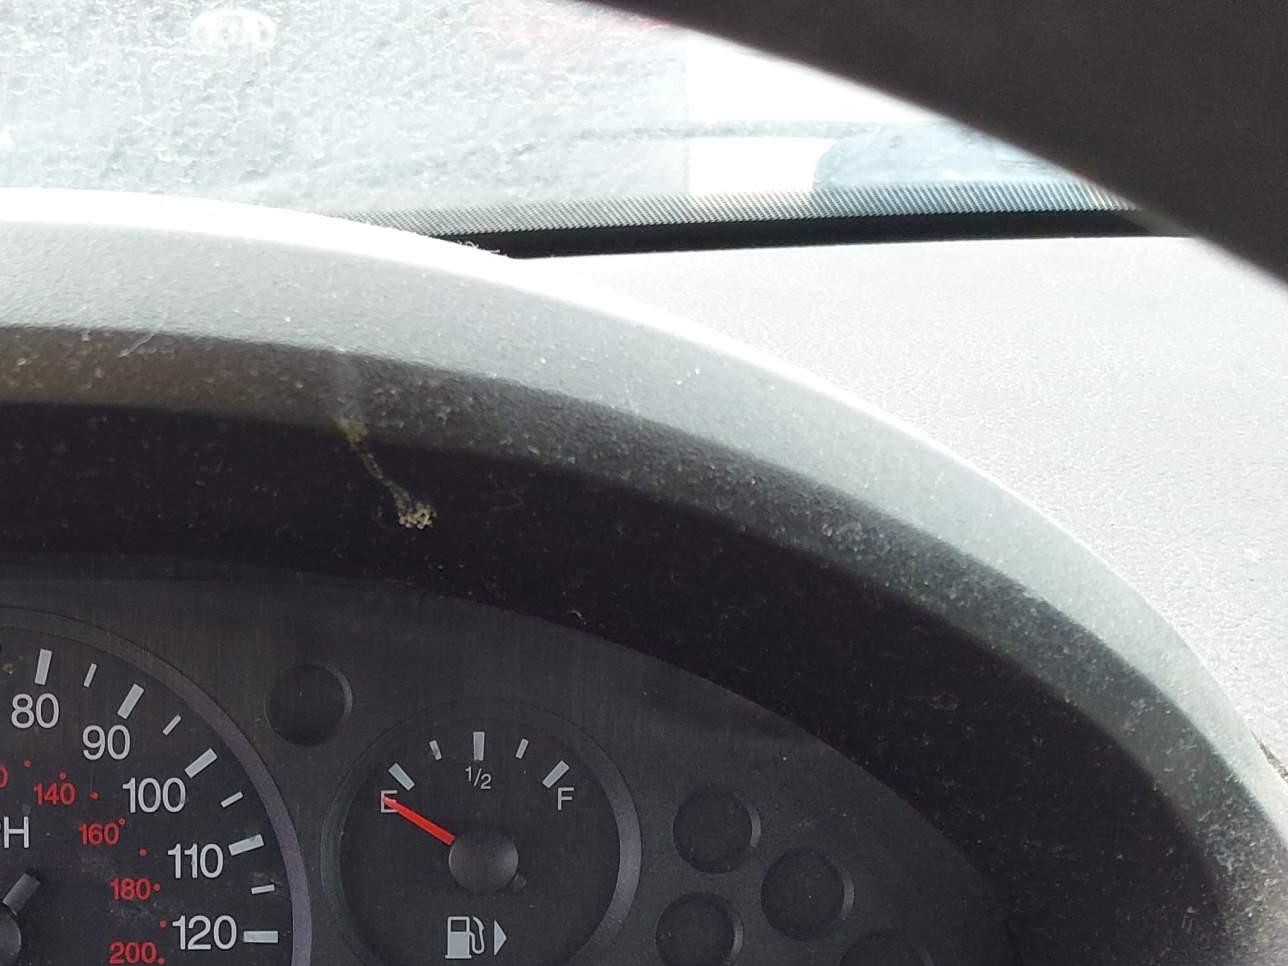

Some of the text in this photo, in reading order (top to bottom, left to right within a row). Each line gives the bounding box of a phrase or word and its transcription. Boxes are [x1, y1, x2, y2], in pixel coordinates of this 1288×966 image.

[11, 692, 60, 729] 80
[82, 725, 131, 761] 90
[464, 765, 492, 791] 1/2
[34, 782, 77, 806] 140
[121, 776, 187, 813] 100
[379, 788, 399, 814] E
[556, 786, 575, 811] F
[79, 823, 120, 846] 160
[167, 843, 224, 879] 110
[110, 878, 151, 900] 180
[171, 915, 237, 950] 120
[109, 942, 155, 965] 200
